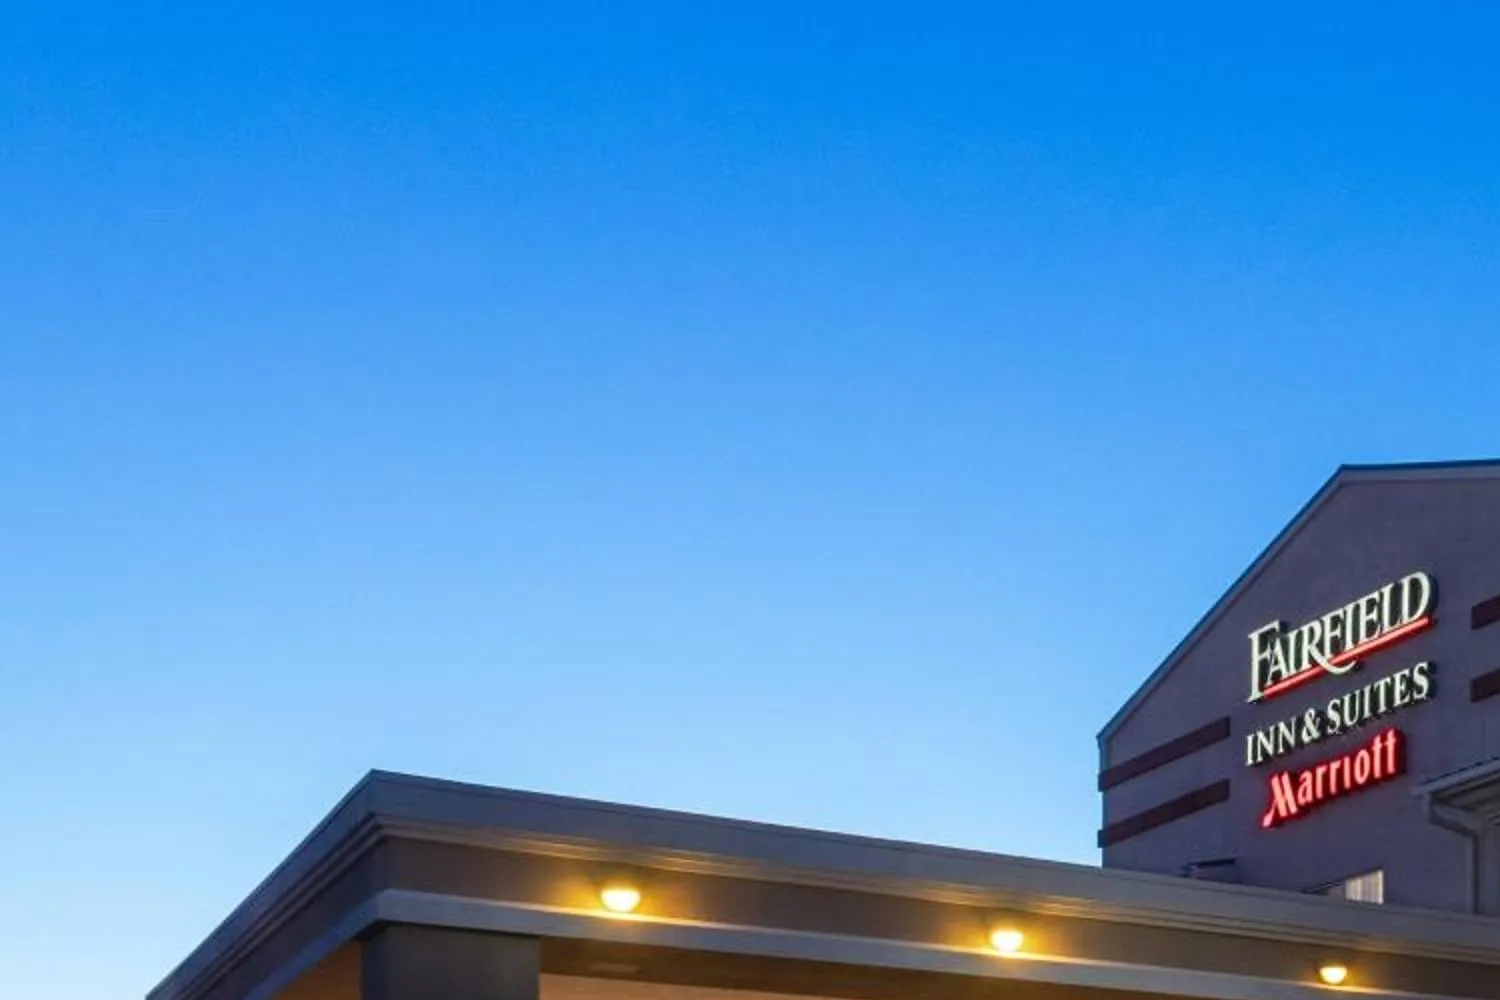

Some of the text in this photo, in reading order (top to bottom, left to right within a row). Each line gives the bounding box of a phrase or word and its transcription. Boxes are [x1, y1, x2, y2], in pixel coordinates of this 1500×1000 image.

[1247, 571, 1431, 702] FAIRFIELD
[1246, 661, 1430, 766] INN & SUITES
[1261, 728, 1398, 828] Marriott
